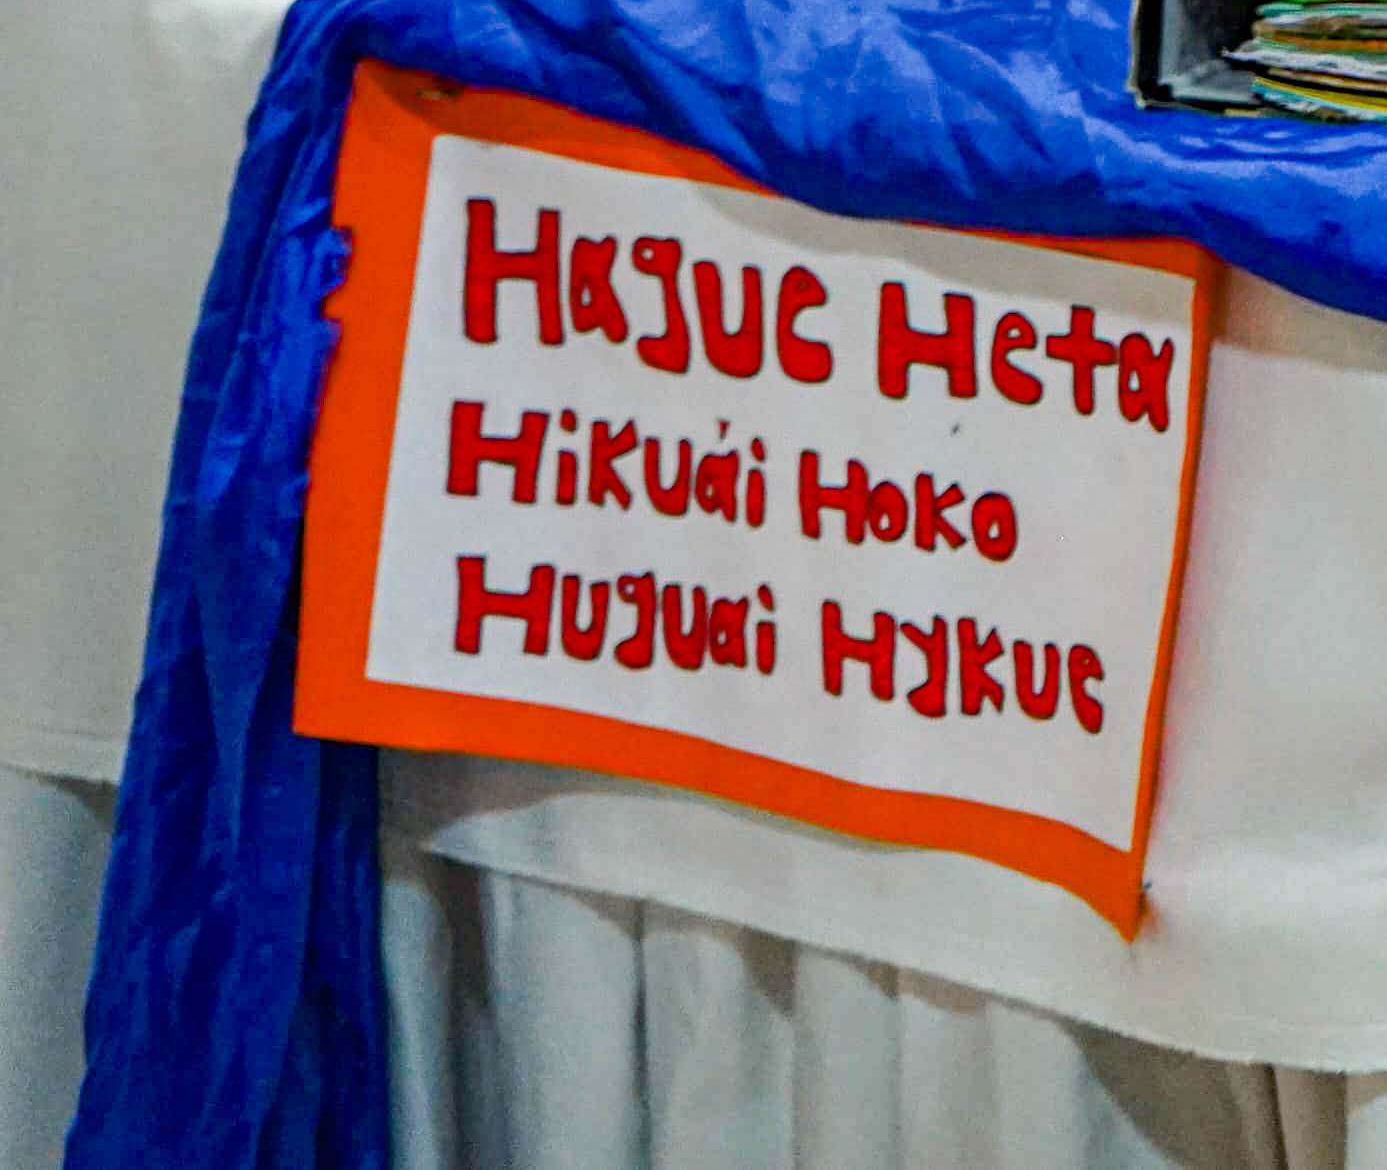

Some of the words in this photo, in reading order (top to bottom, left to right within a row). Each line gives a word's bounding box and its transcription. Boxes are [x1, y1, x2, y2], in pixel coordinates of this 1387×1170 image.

[461, 197, 835, 384] Hague
[876, 280, 1177, 434] Heta
[797, 448, 1019, 563] Hoko
[453, 554, 778, 676] Huguai
